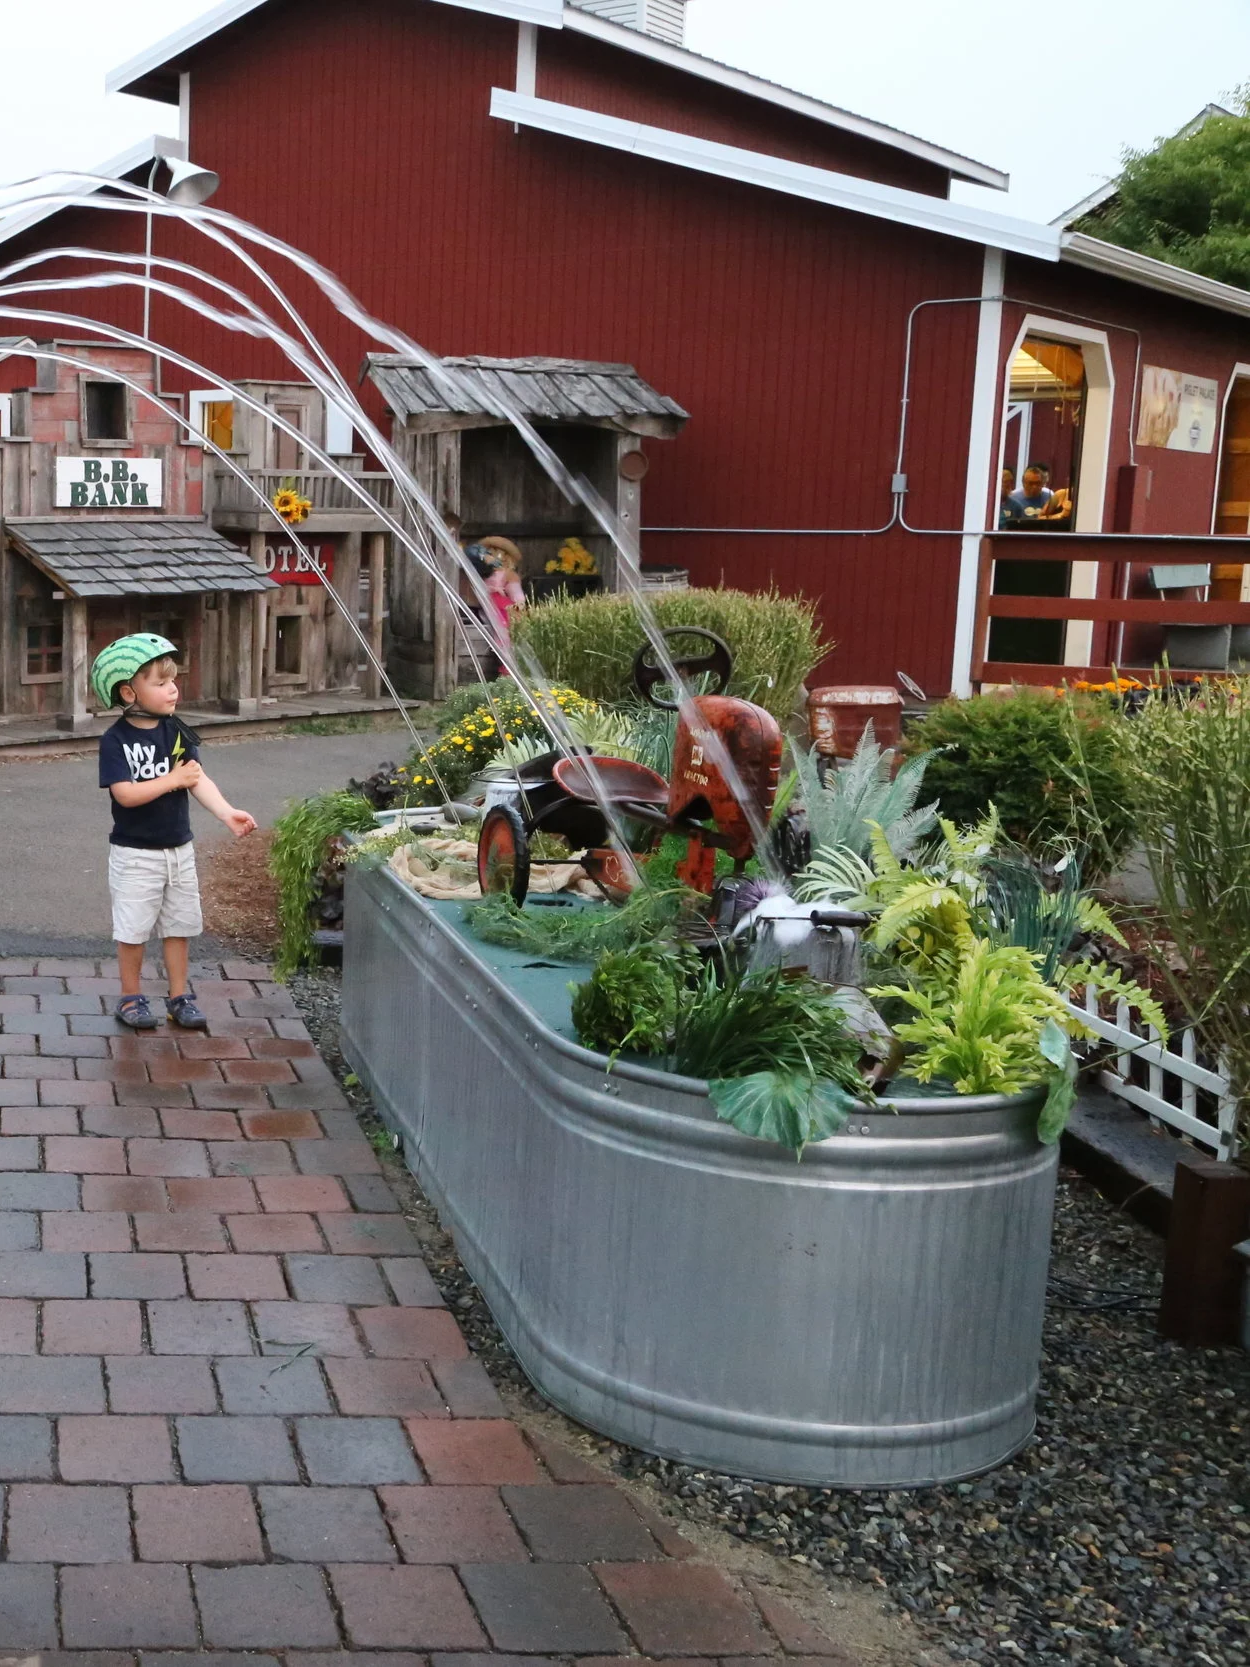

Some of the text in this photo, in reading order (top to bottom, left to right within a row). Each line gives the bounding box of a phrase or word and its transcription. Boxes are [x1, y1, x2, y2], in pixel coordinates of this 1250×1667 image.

[83, 460, 138, 483] B.B.
[70, 481, 149, 506] BANK
[241, 545, 327, 572] OTEL
[123, 743, 155, 765] My
[129, 757, 170, 780] Dad
